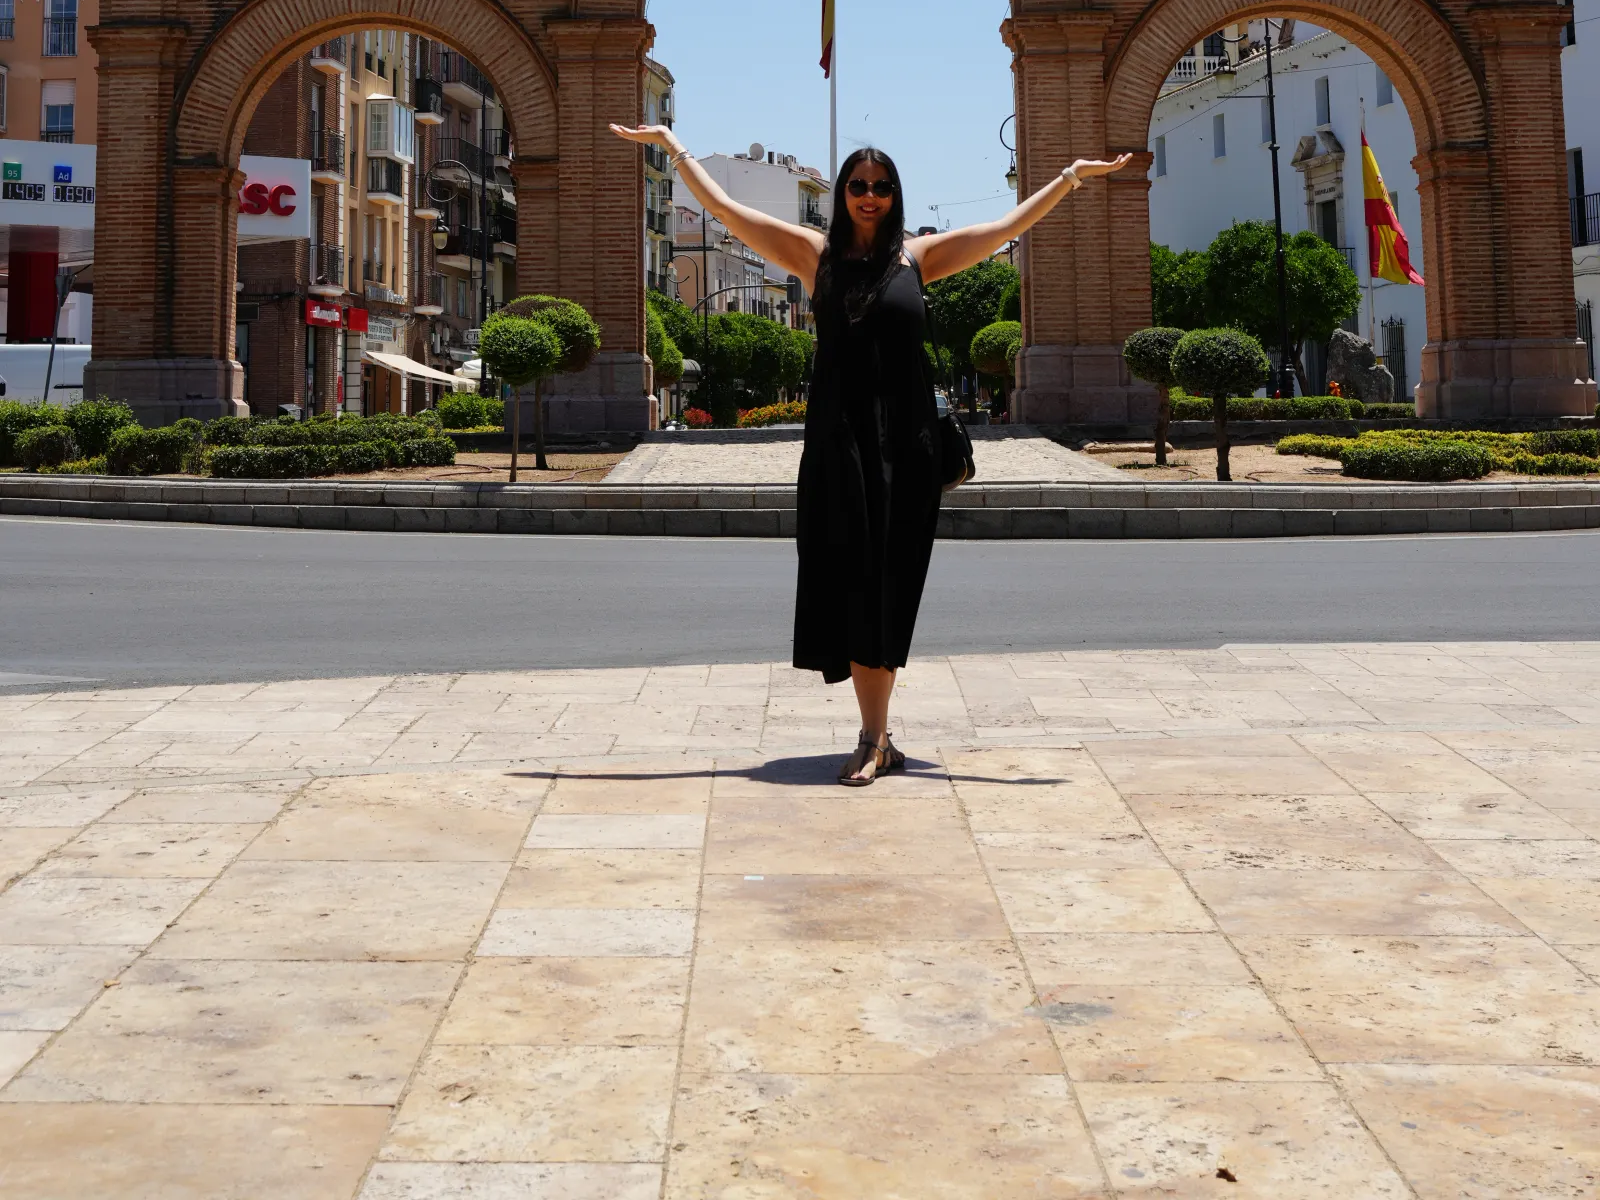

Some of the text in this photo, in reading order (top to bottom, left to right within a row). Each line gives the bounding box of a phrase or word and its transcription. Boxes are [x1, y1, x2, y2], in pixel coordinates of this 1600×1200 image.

[8, 170, 18, 178] 95
[58, 172, 70, 181] Ad
[9, 184, 45, 200] 1.409
[53, 186, 94, 203] 0.890
